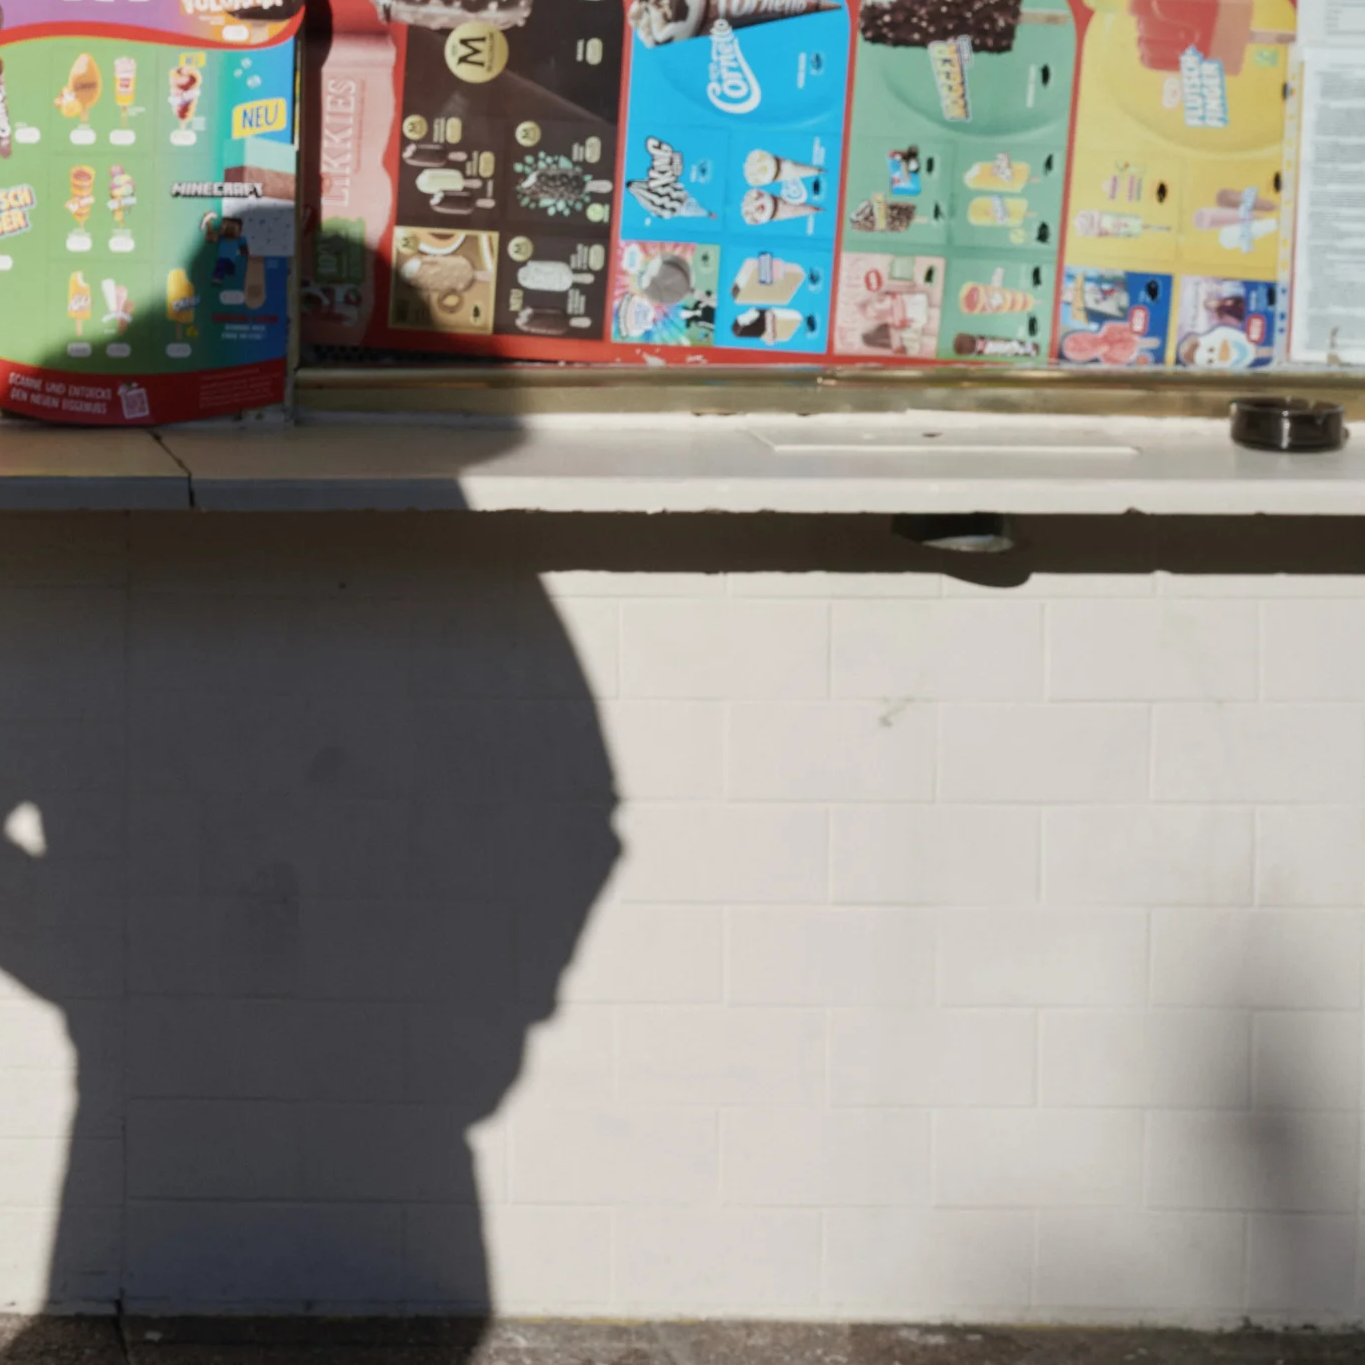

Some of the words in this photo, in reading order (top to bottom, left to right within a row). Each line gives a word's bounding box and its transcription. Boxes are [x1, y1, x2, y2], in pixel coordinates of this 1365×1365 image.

[457, 36, 488, 68] M
[706, 19, 762, 114] Cornetto
[240, 102, 279, 130] NEU
[171, 181, 264, 198] MINECRAFT
